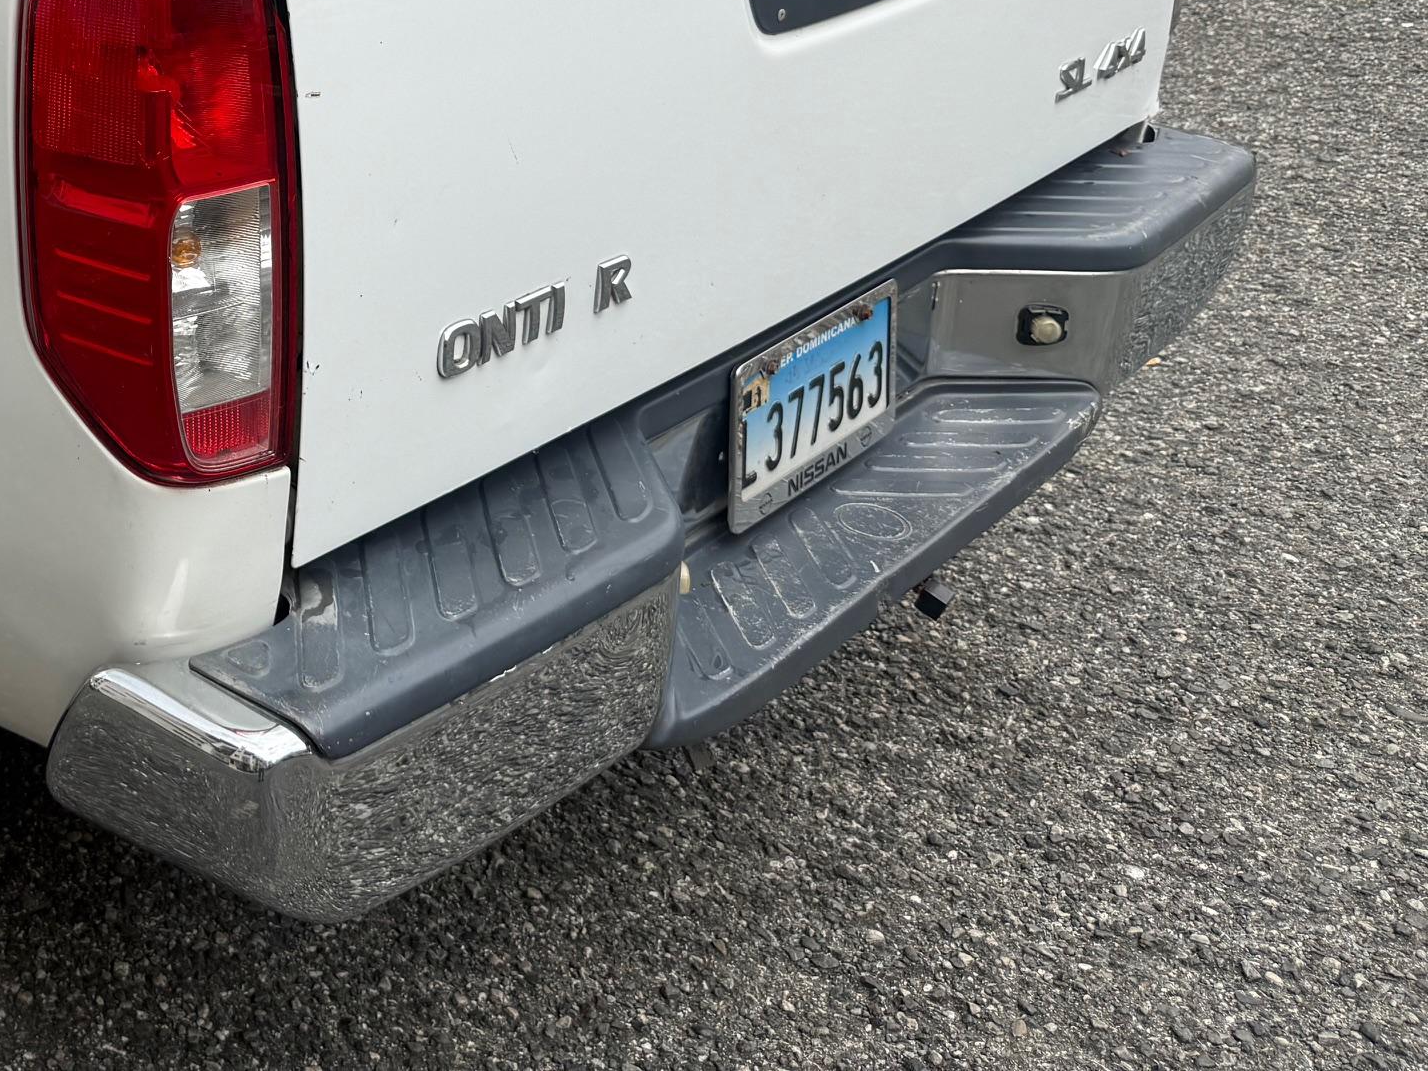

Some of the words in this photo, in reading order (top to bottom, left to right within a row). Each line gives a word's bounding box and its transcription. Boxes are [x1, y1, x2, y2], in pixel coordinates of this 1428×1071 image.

[1055, 57, 1092, 103] SL
[437, 281, 566, 379] ONTI
[593, 254, 633, 313] R
[796, 316, 857, 359] DOMINICANA
[741, 341, 883, 489] L377563
[787, 442, 847, 497] NISSAN
